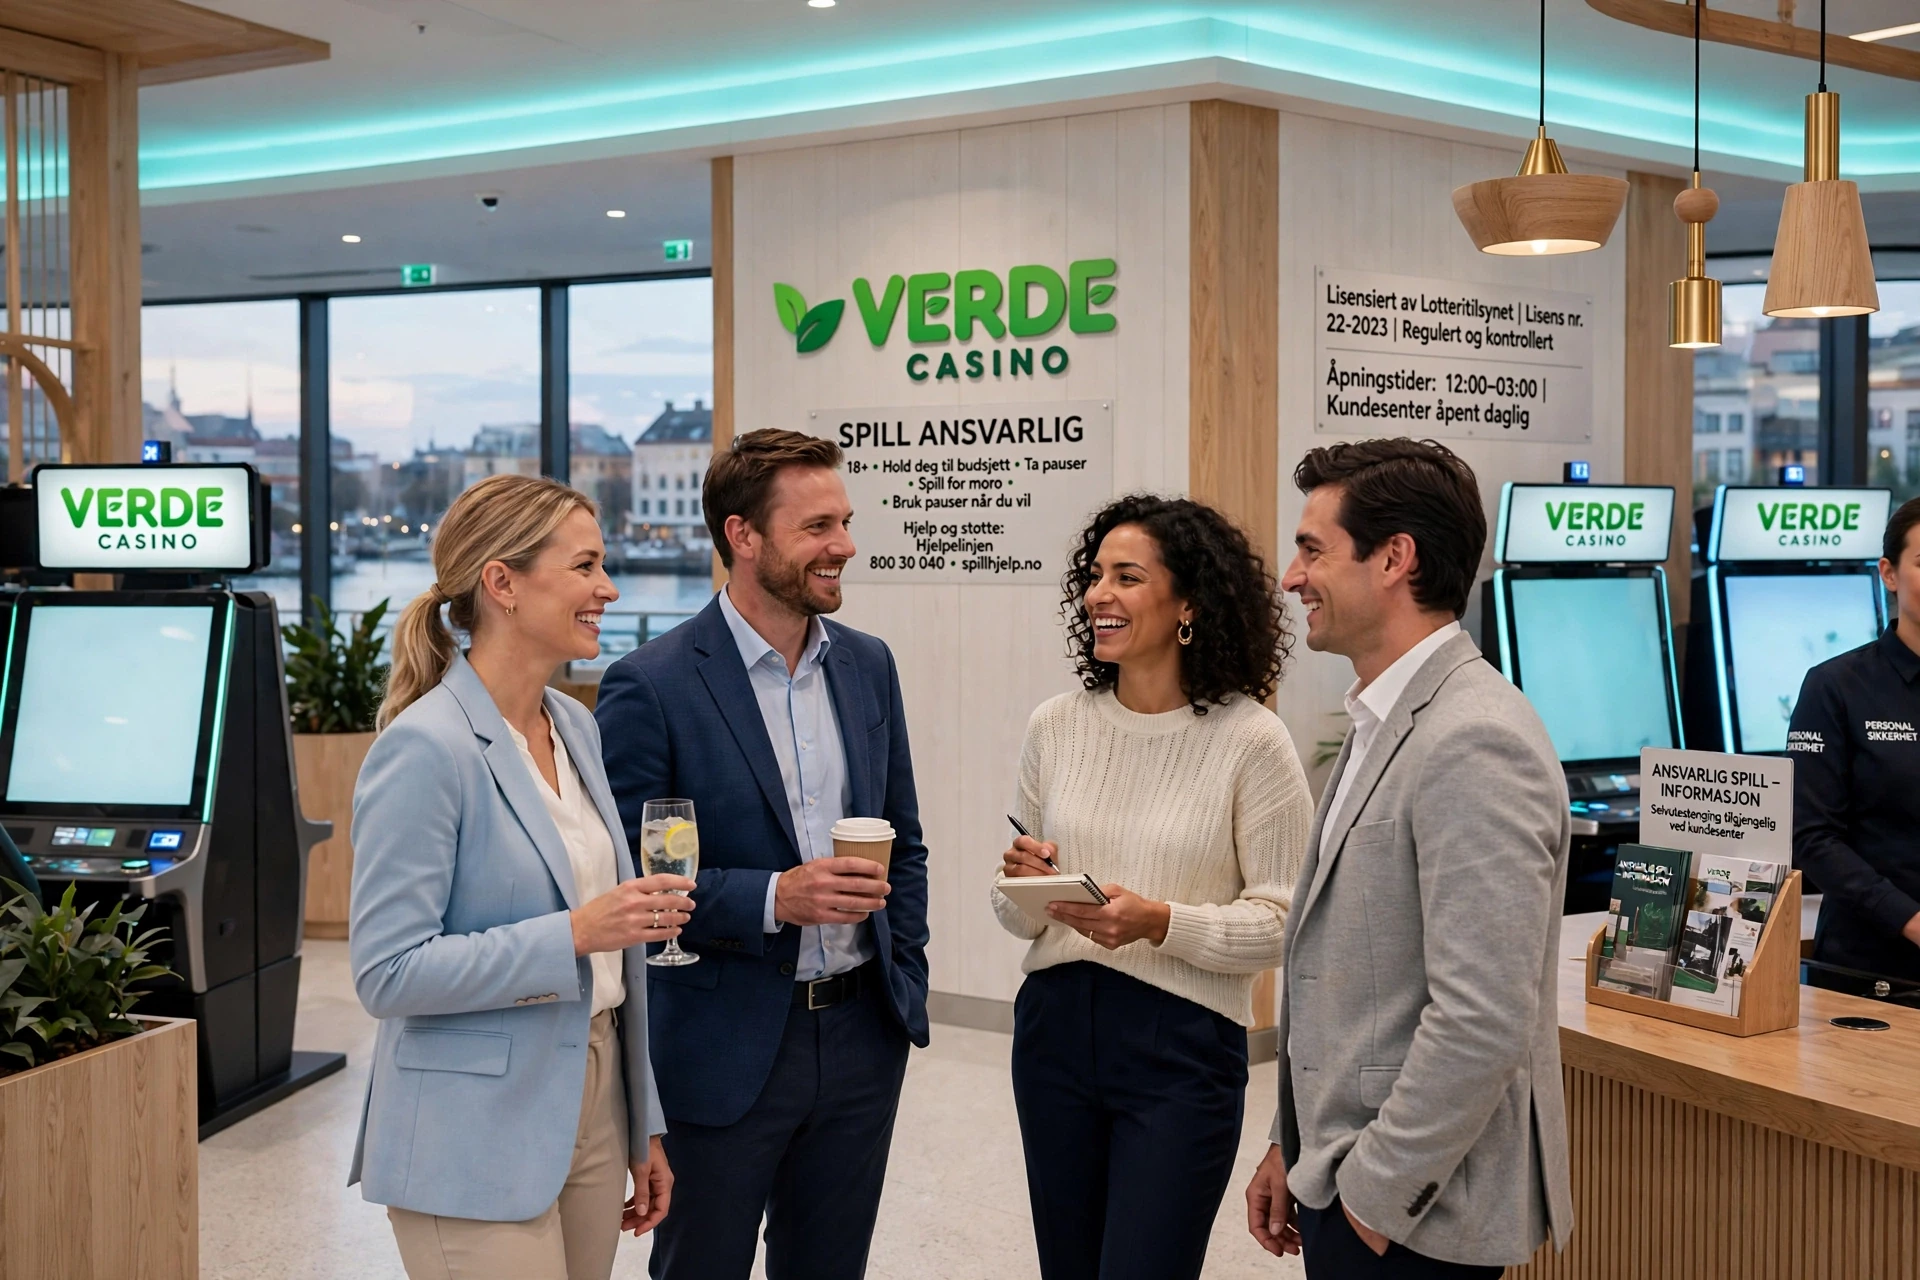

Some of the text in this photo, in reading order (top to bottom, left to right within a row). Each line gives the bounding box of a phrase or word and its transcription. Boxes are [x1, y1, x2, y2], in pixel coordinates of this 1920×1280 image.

[852, 258, 1117, 347] VERDE
[1327, 284, 1397, 311] Lisensiert
[1400, 297, 1417, 310] av
[1420, 294, 1514, 323] Lotteritilsynet
[1526, 304, 1564, 325] Lisens
[1568, 312, 1583, 327] nr.
[1326, 313, 1388, 336] 22-2023
[1402, 319, 1462, 345] Regulert
[1465, 329, 1482, 349] og
[1486, 327, 1554, 350] kontrollert
[906, 345, 1069, 381] CASINO
[1327, 358, 1436, 394] Åpningstider:
[1446, 373, 1537, 398] 12:00–03:00
[1327, 395, 1530, 429] Kundesenter åpent daglig
[838, 415, 1083, 448] SPILL ANSVARLIG
[847, 457, 1087, 476] 18+ Hold deg til budsjett Ta pauser
[918, 476, 1003, 493] Spill for moro
[61, 487, 224, 528] VERDE
[892, 493, 1031, 514] Bruk pauser når du vil
[1545, 501, 1644, 531] VERDE
[1757, 503, 1861, 531] VERDE
[904, 521, 1004, 537] Hjelp og stotte:
[98, 534, 197, 550] CASINO
[916, 539, 993, 555] Hjelpelinjen
[1565, 534, 1627, 547] CASINO
[1778, 534, 1842, 546] CASINO
[869, 555, 1042, 574] 800 30 040 spillhjelp.no
[1864, 720, 1915, 731] PERSONAL
[1866, 731, 1918, 741] SIKKERHET
[1652, 763, 1728, 784] ANSVARLIG
[1731, 771, 1768, 788] SPILL
[1661, 783, 1760, 807] INFORMASJON
[1669, 820, 1745, 839] ved kundesenter
[1724, 811, 1776, 831] tilgjengelig
